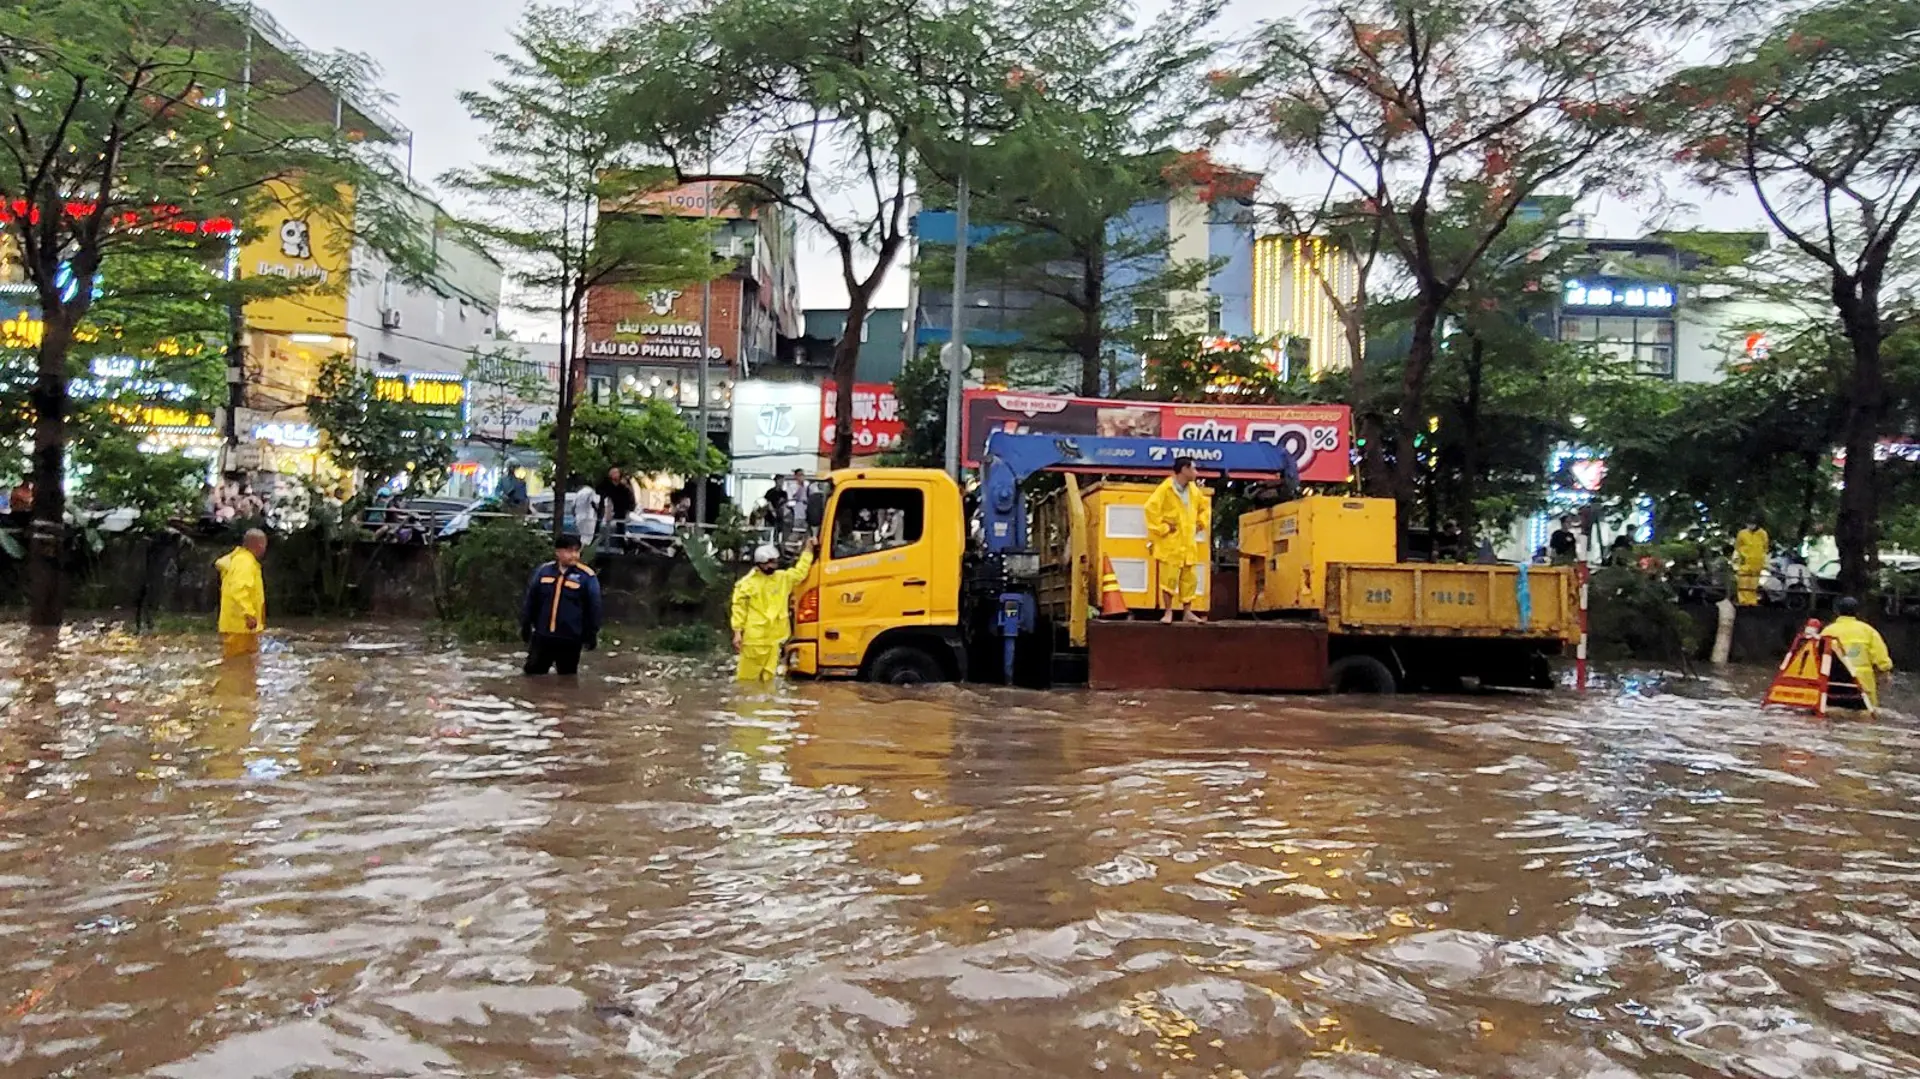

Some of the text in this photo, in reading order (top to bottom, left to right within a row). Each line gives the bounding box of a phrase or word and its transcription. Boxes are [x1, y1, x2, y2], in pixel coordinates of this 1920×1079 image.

[619, 341, 639, 356] BÒ
[641, 345, 679, 358] PHAN
[1183, 423, 1233, 441] GIẢM
[1171, 447, 1223, 461] TADANO
